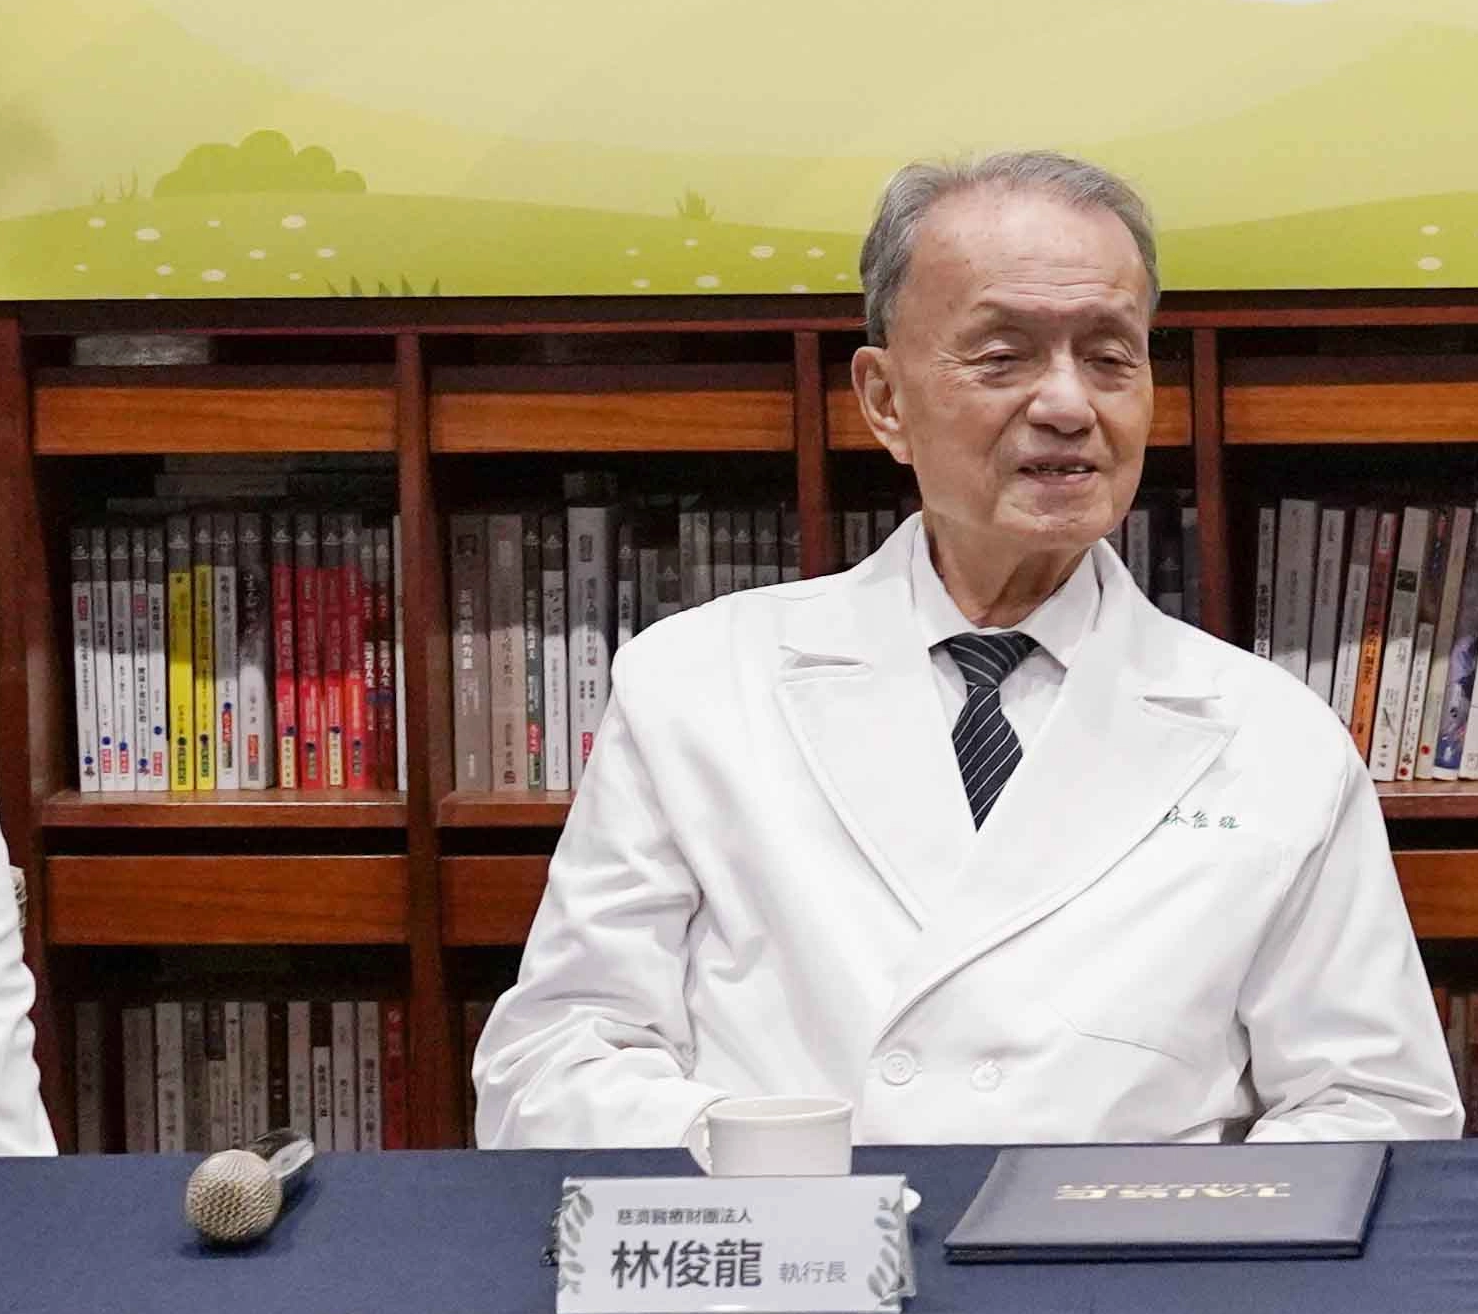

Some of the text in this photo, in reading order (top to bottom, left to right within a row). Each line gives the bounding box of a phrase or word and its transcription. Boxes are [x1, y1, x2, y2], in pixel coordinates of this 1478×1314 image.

[616, 1208, 754, 1225] 慈濟醫療財團法人
[610, 1239, 850, 1289] 林俊龍 執行長
